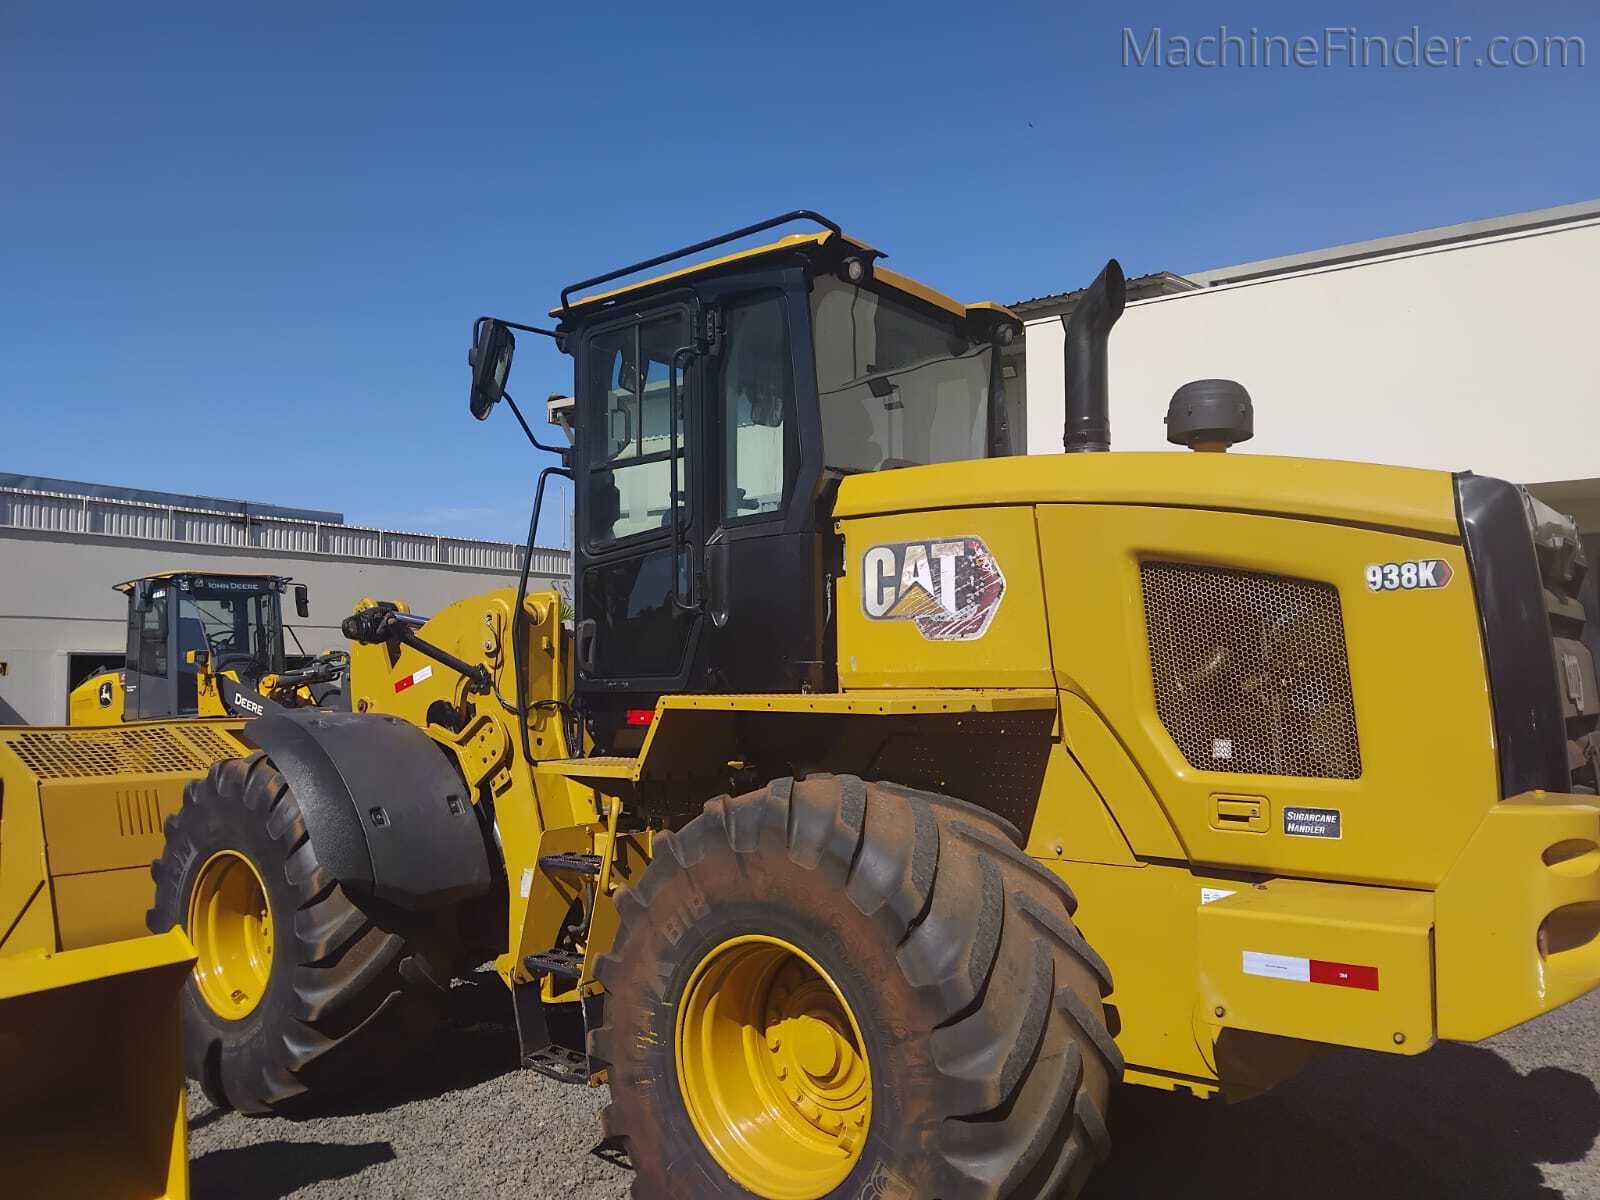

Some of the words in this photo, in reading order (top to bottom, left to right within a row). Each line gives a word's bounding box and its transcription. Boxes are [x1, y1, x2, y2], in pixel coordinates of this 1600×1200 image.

[864, 541, 965, 617] CAT
[1366, 561, 1438, 590] 938K
[234, 692, 264, 716] DEERE
[1287, 811, 1337, 823] SUGARCANE
[1287, 823, 1325, 834] HANDLER
